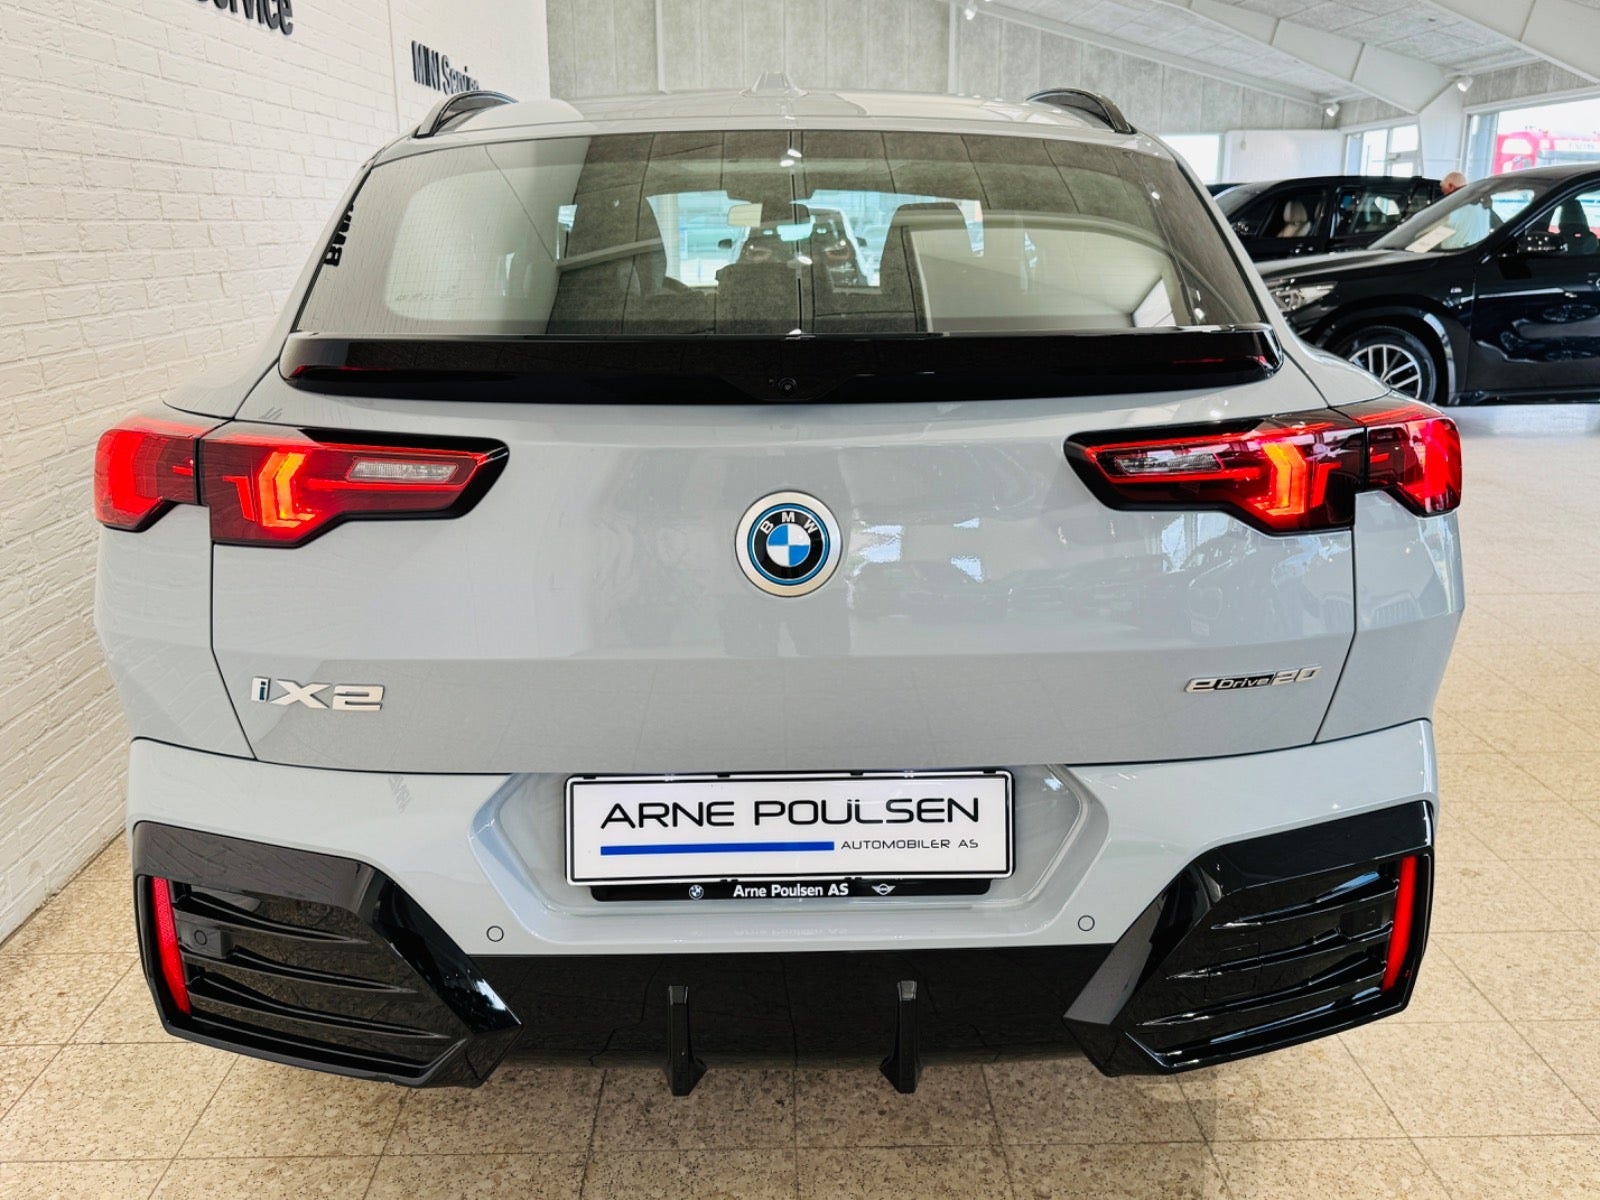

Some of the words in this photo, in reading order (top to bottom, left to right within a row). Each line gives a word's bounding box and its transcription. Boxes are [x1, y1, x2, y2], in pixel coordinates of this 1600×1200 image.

[411, 40, 441, 91] MINI
[760, 511, 819, 535] BMW
[1184, 664, 1323, 693] eDrive20
[251, 676, 385, 712] iX2
[600, 801, 735, 830] ARNE
[754, 797, 979, 826] POULSEN
[840, 839, 951, 850] AUTOMOBILER
[957, 838, 979, 849] AS
[733, 884, 767, 898] Arne
[771, 883, 823, 898] Poulsen
[827, 883, 850, 896] AS
